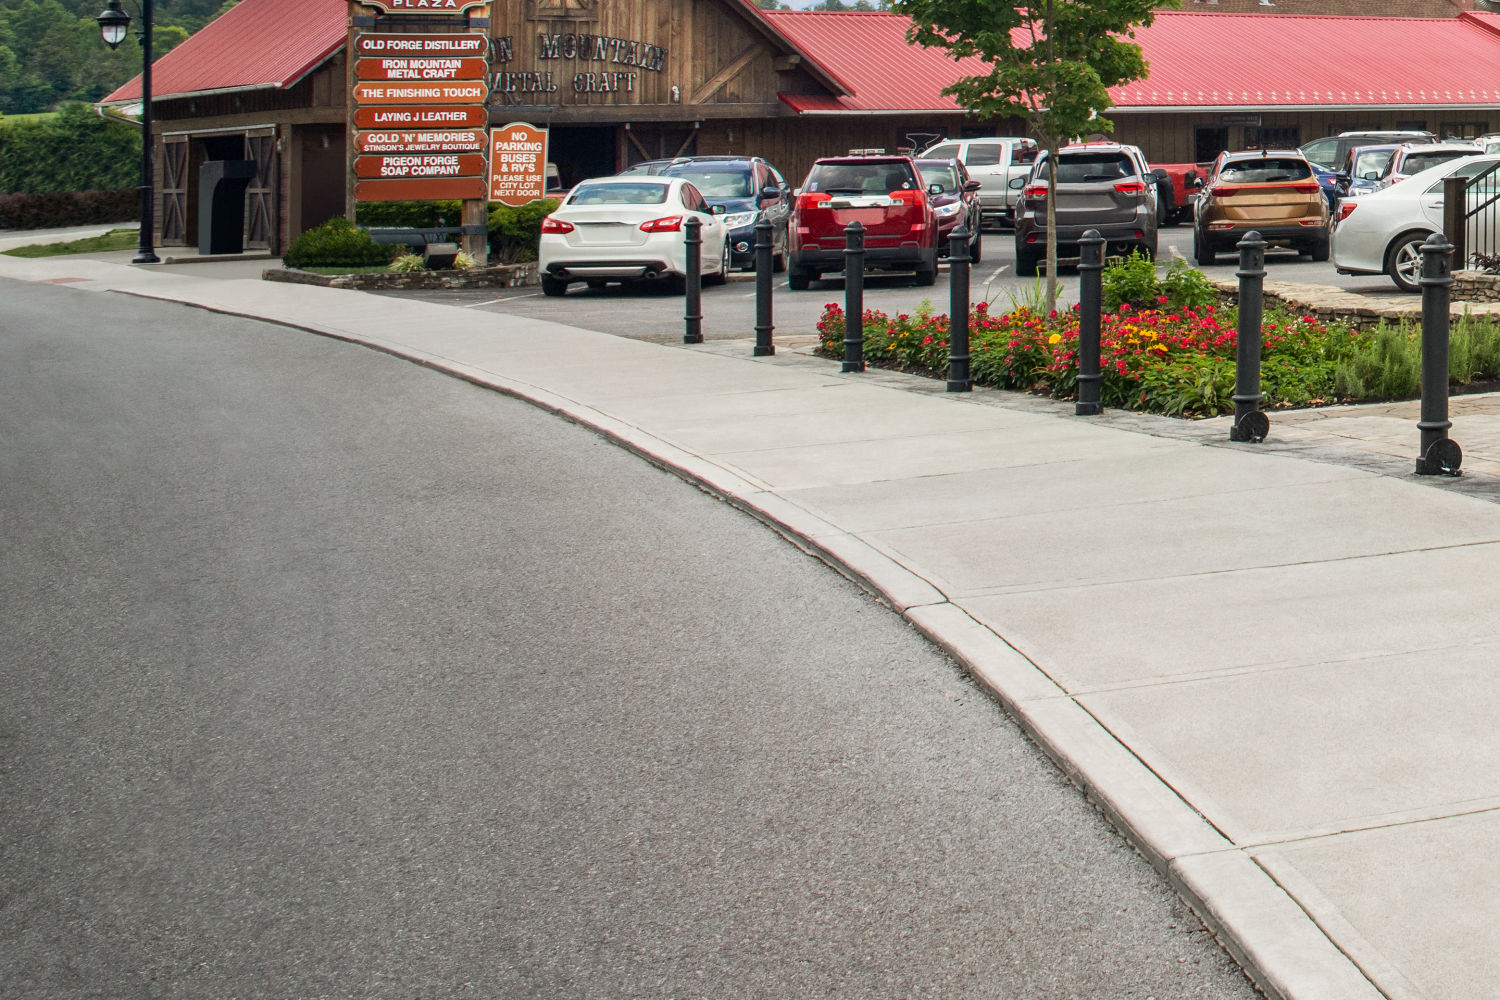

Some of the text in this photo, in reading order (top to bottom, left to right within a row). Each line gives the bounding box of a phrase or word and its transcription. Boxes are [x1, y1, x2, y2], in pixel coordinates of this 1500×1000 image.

[392, 0, 457, 8] PLAZA
[362, 39, 481, 50] OLD FORGE DISTILLERY
[540, 33, 668, 72] MOUNTAIN
[382, 60, 462, 69] IRON MOUNTAIN
[387, 69, 457, 78] METAL CRAFT
[573, 72, 638, 93] CRAFT
[361, 87, 481, 98] THE FINISHING TOUCH
[374, 111, 468, 121] LAYING J LEATHER
[367, 133, 400, 143] GOLD
[418, 132, 476, 142] MEMORIES
[511, 132, 528, 141] NO
[363, 144, 404, 152] STINSON'S
[442, 142, 481, 150] BOUTIQUE
[495, 142, 543, 151] PARKING
[382, 156, 459, 166] PIGEON FORGE
[500, 153, 537, 163] BUSES
[381, 166, 460, 176] SOAP COMPANY
[501, 163, 536, 172] & RV'S
[493, 174, 542, 182] PLEASE USE
[516, 189, 541, 197] DOOR
